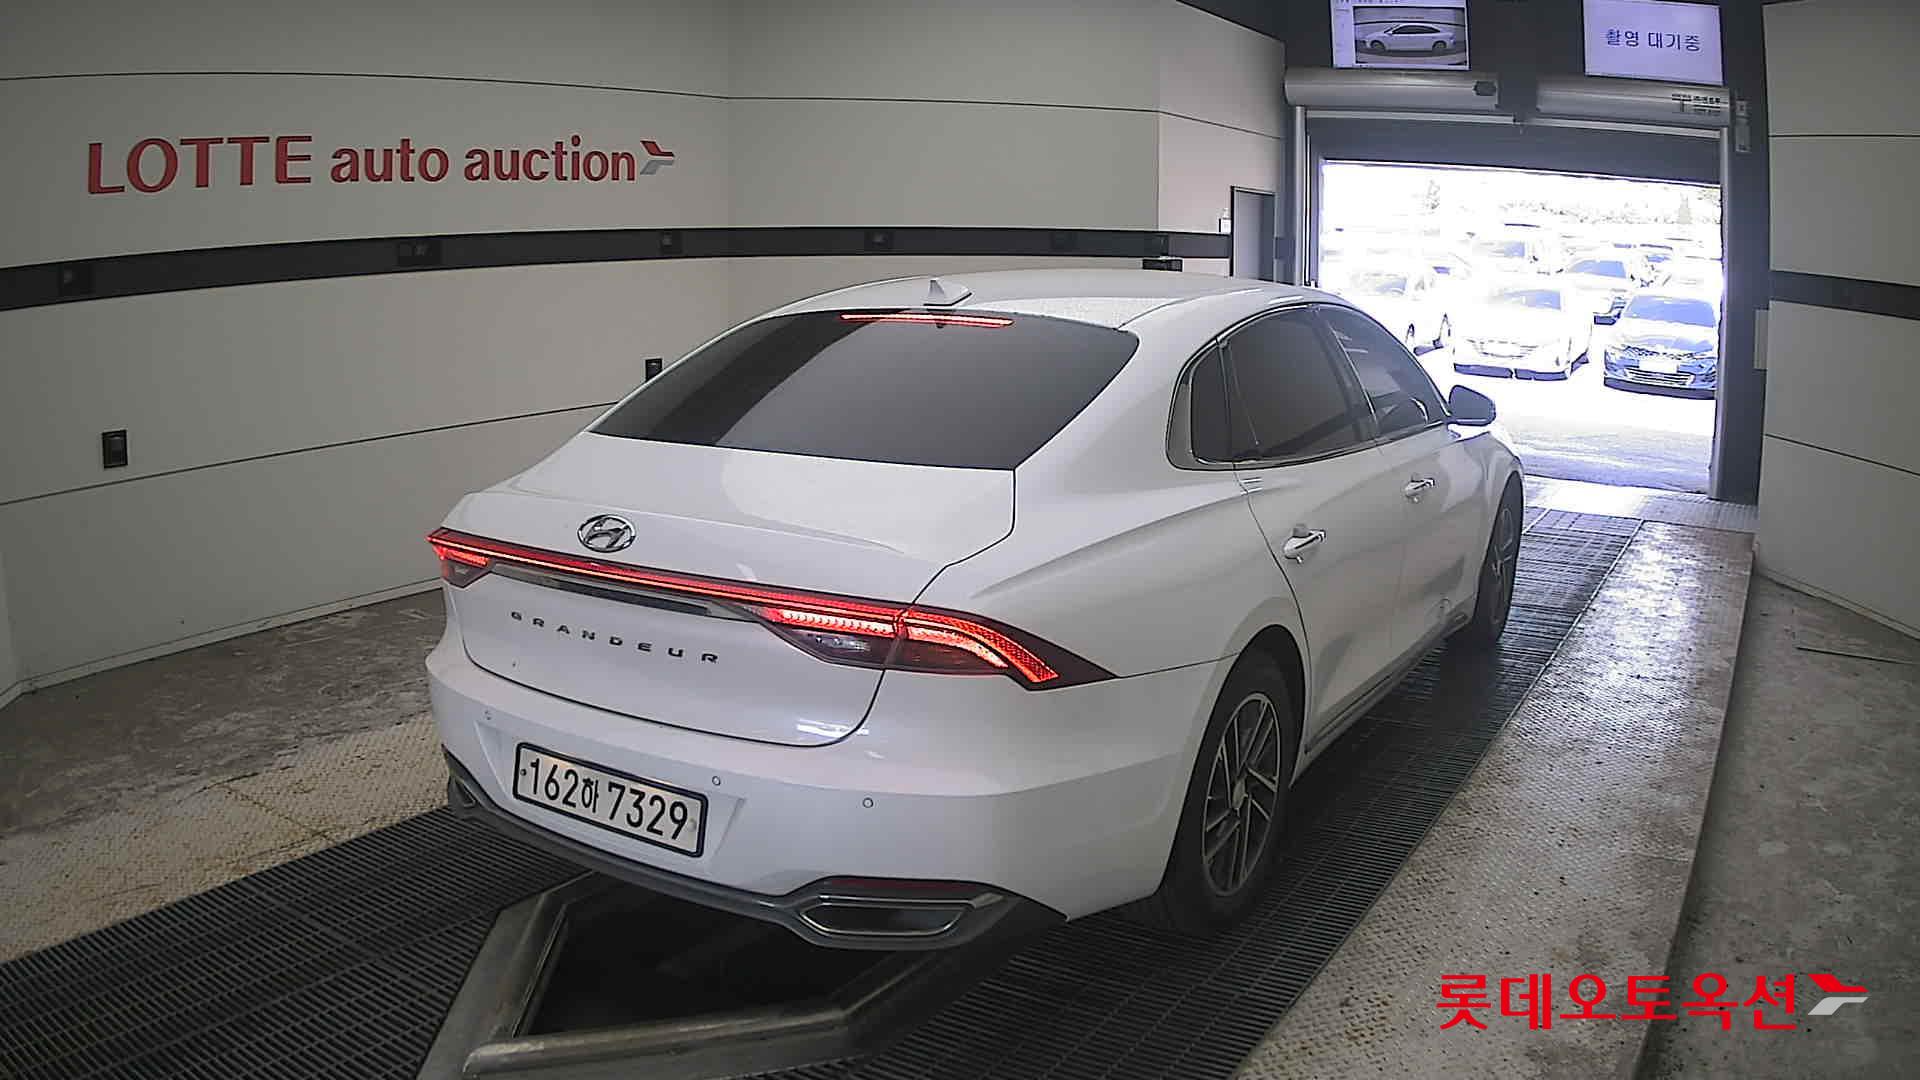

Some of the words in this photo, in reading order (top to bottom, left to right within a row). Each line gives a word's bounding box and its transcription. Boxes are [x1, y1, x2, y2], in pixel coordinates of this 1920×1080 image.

[1607, 28, 1640, 48] 촬영
[1647, 31, 1701, 52] 대기중
[87, 135, 313, 195] LOTTE
[330, 137, 450, 184] auto
[463, 134, 636, 183] auction
[510, 610, 719, 664] GRANDEUR
[529, 757, 600, 814] 162하
[607, 781, 689, 841] 7329
